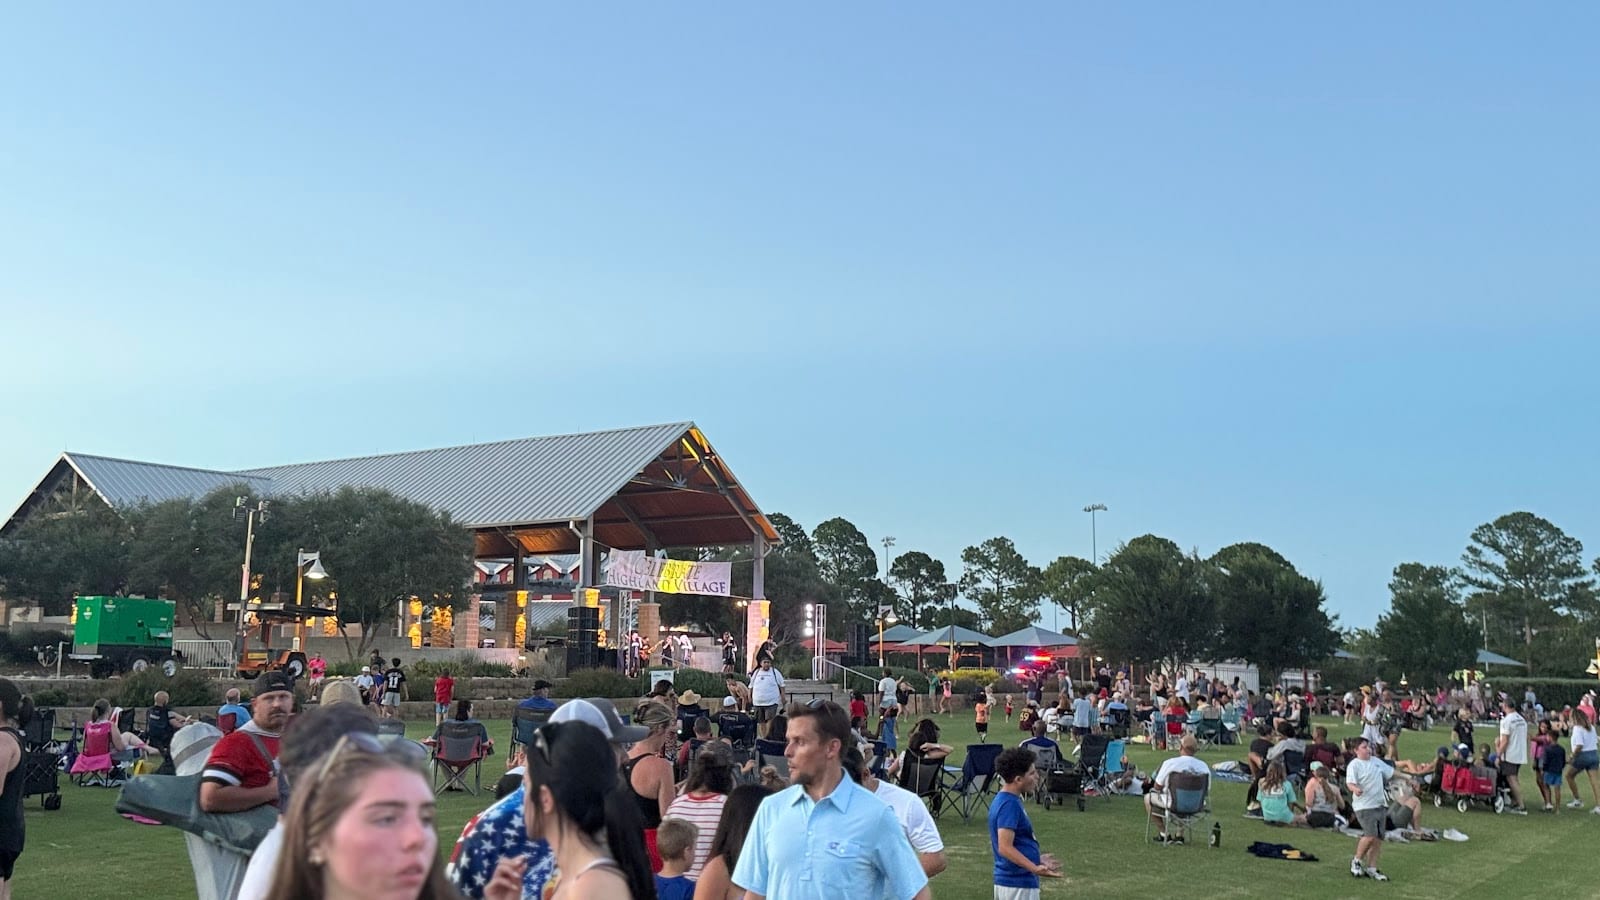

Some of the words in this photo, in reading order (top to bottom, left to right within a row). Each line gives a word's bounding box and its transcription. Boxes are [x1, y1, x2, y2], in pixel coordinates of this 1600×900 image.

[608, 568, 670, 590] HIGHLAND
[674, 579, 726, 594] VILLAGE
[388, 676, 399, 689] 11
